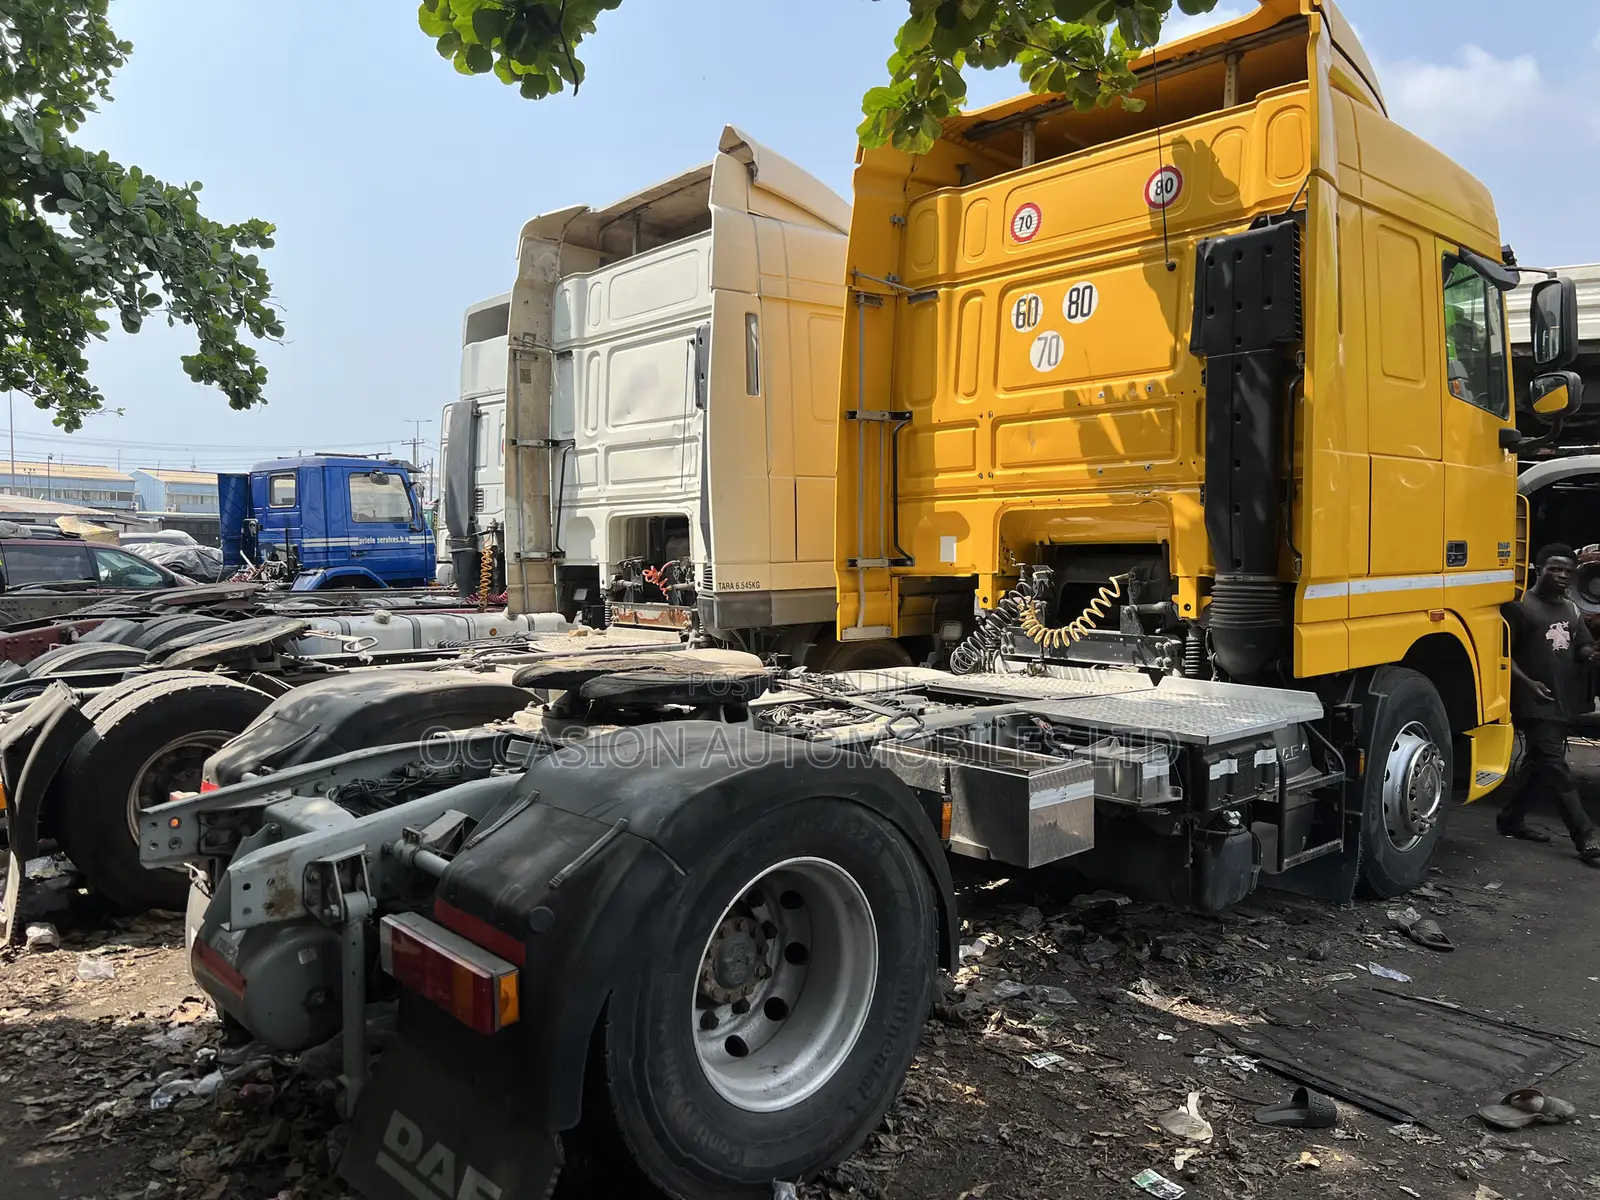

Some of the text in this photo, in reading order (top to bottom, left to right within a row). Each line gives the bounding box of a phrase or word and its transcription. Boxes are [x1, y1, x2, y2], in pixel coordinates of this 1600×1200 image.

[1155, 177, 1174, 196] 80
[1018, 214, 1033, 232] 70
[1015, 295, 1039, 329] 60
[1067, 284, 1094, 320] 80
[1036, 334, 1060, 368] 70
[718, 580, 760, 590] TARA 6.545KG
[382, 1108, 503, 1200] DAF
